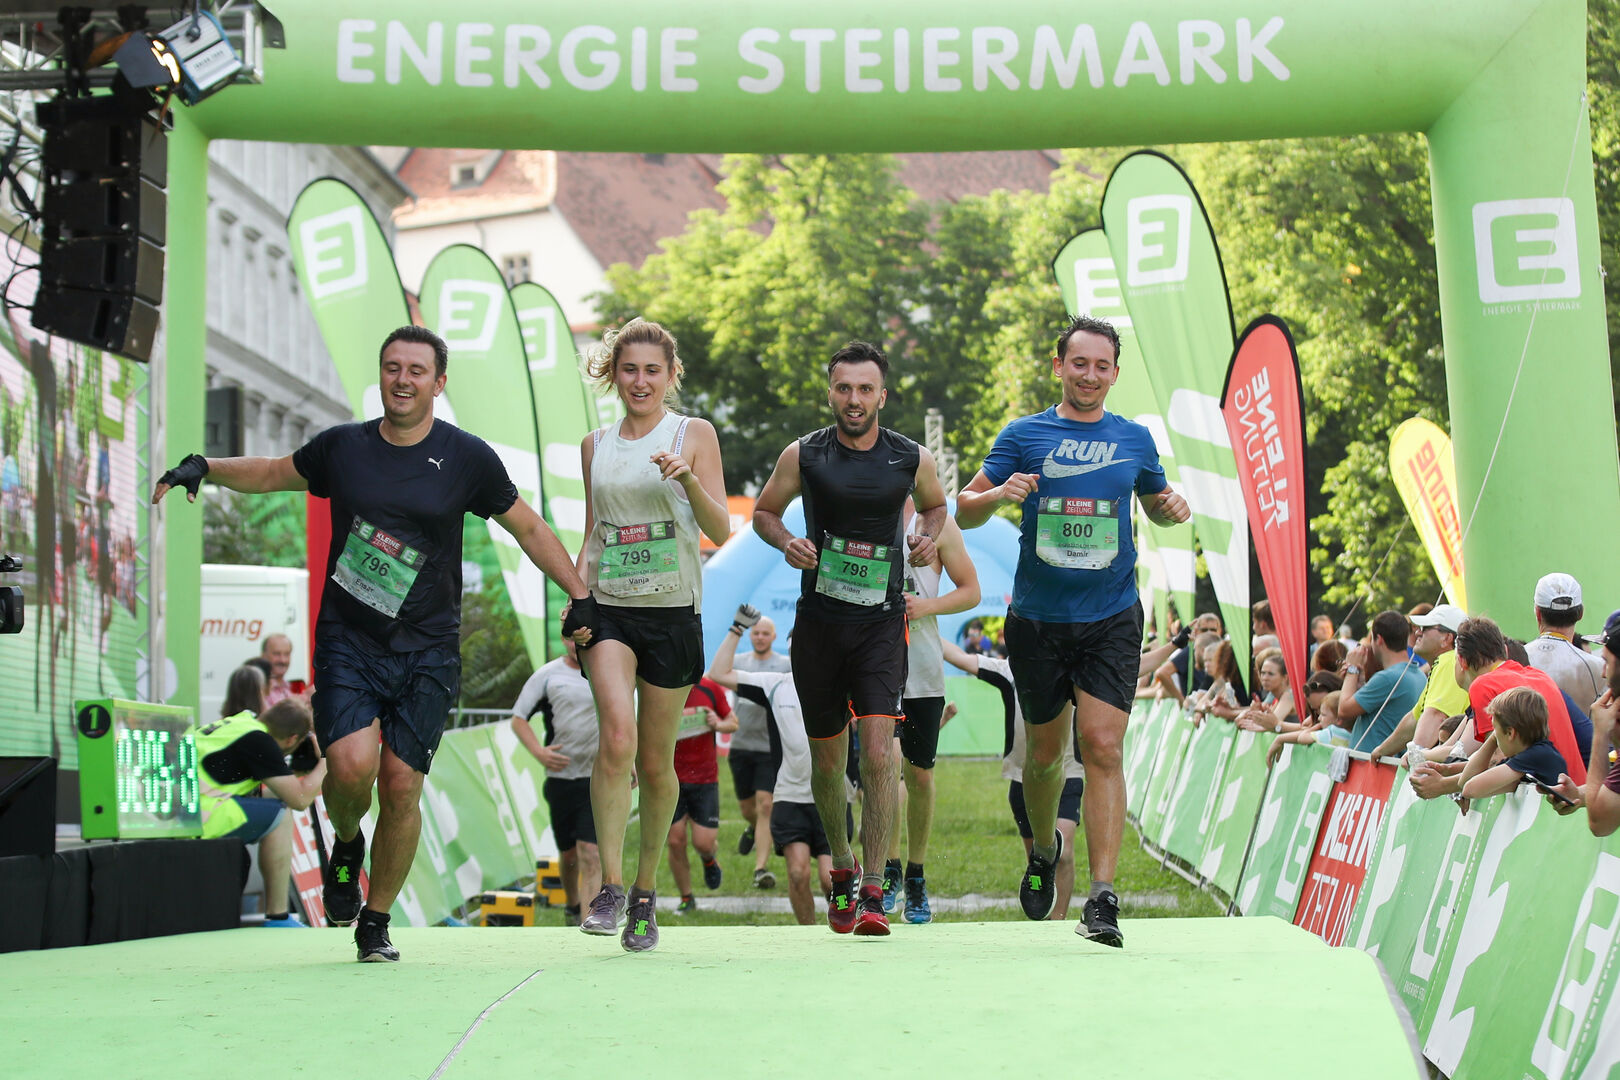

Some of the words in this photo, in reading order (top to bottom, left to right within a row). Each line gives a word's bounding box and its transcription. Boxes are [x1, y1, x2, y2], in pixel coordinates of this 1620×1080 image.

[336, 18, 700, 92] ENERGIE
[737, 16, 1291, 94] STEIERMARK
[1482, 304, 1522, 317] ENERGIE
[1526, 301, 1581, 313] STEIERMARK
[1056, 438, 1118, 463] RUN
[620, 526, 646, 536] KLEINE
[1062, 522, 1093, 538] 800
[375, 532, 401, 549] KLEINE
[848, 542, 872, 551] KLEINE
[620, 549, 651, 566] 799
[847, 548, 871, 558] ZEITUNG
[361, 551, 390, 577] 796
[842, 561, 868, 578] 798
[628, 577, 650, 586] Vanja
[88, 706, 100, 730] 1
